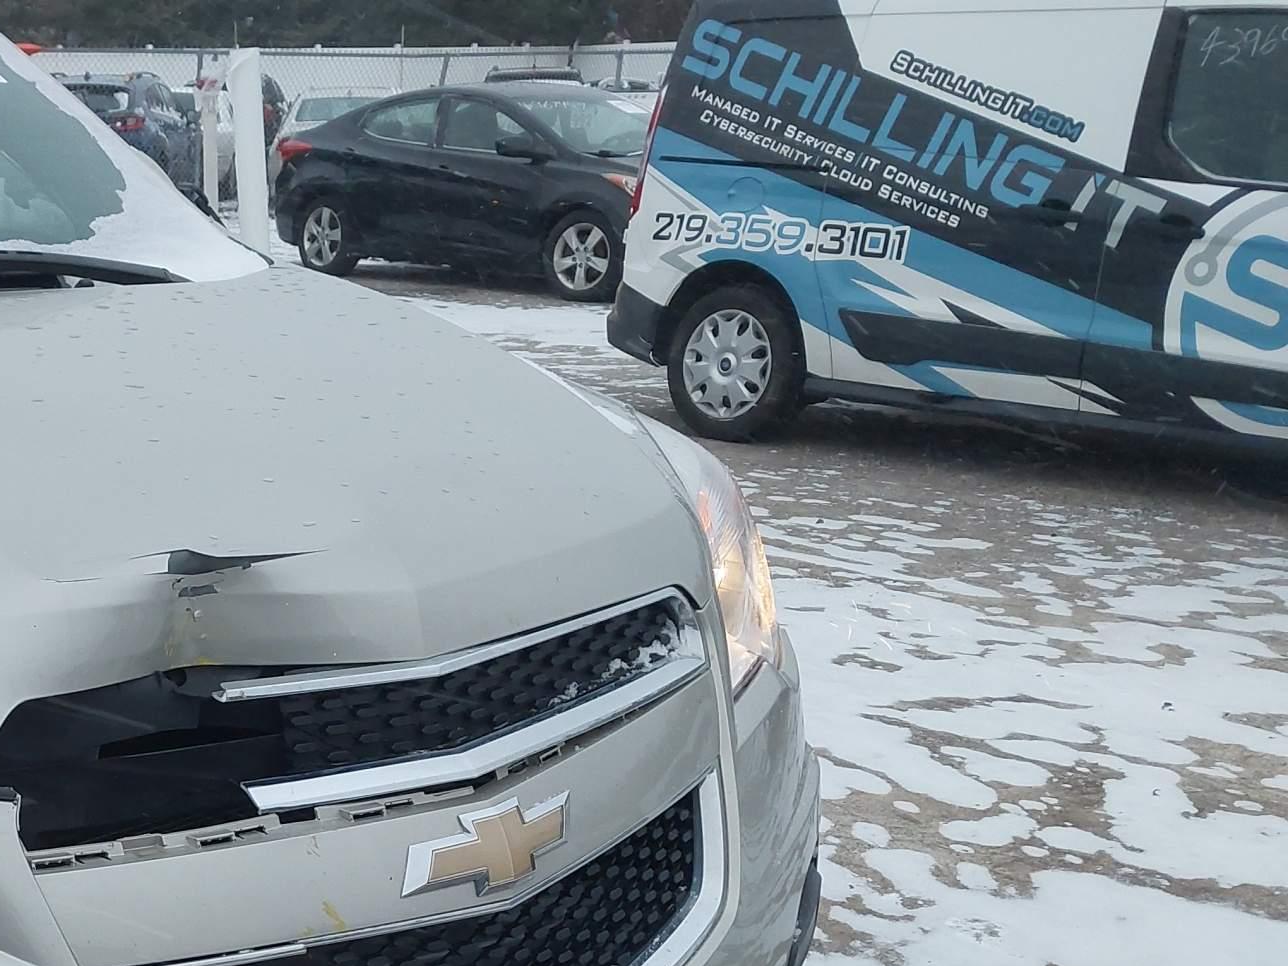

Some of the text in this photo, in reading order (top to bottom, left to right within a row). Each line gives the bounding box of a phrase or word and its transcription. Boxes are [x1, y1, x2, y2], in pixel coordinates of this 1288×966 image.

[680, 18, 1169, 249] SCHILLING IT
[691, 85, 990, 219] MANAGED IT SERVICES IT CONSULTING
[699, 109, 962, 229] CYBERSECURITY CLOUD SERVICES
[652, 211, 909, 261] 219.359.3101
